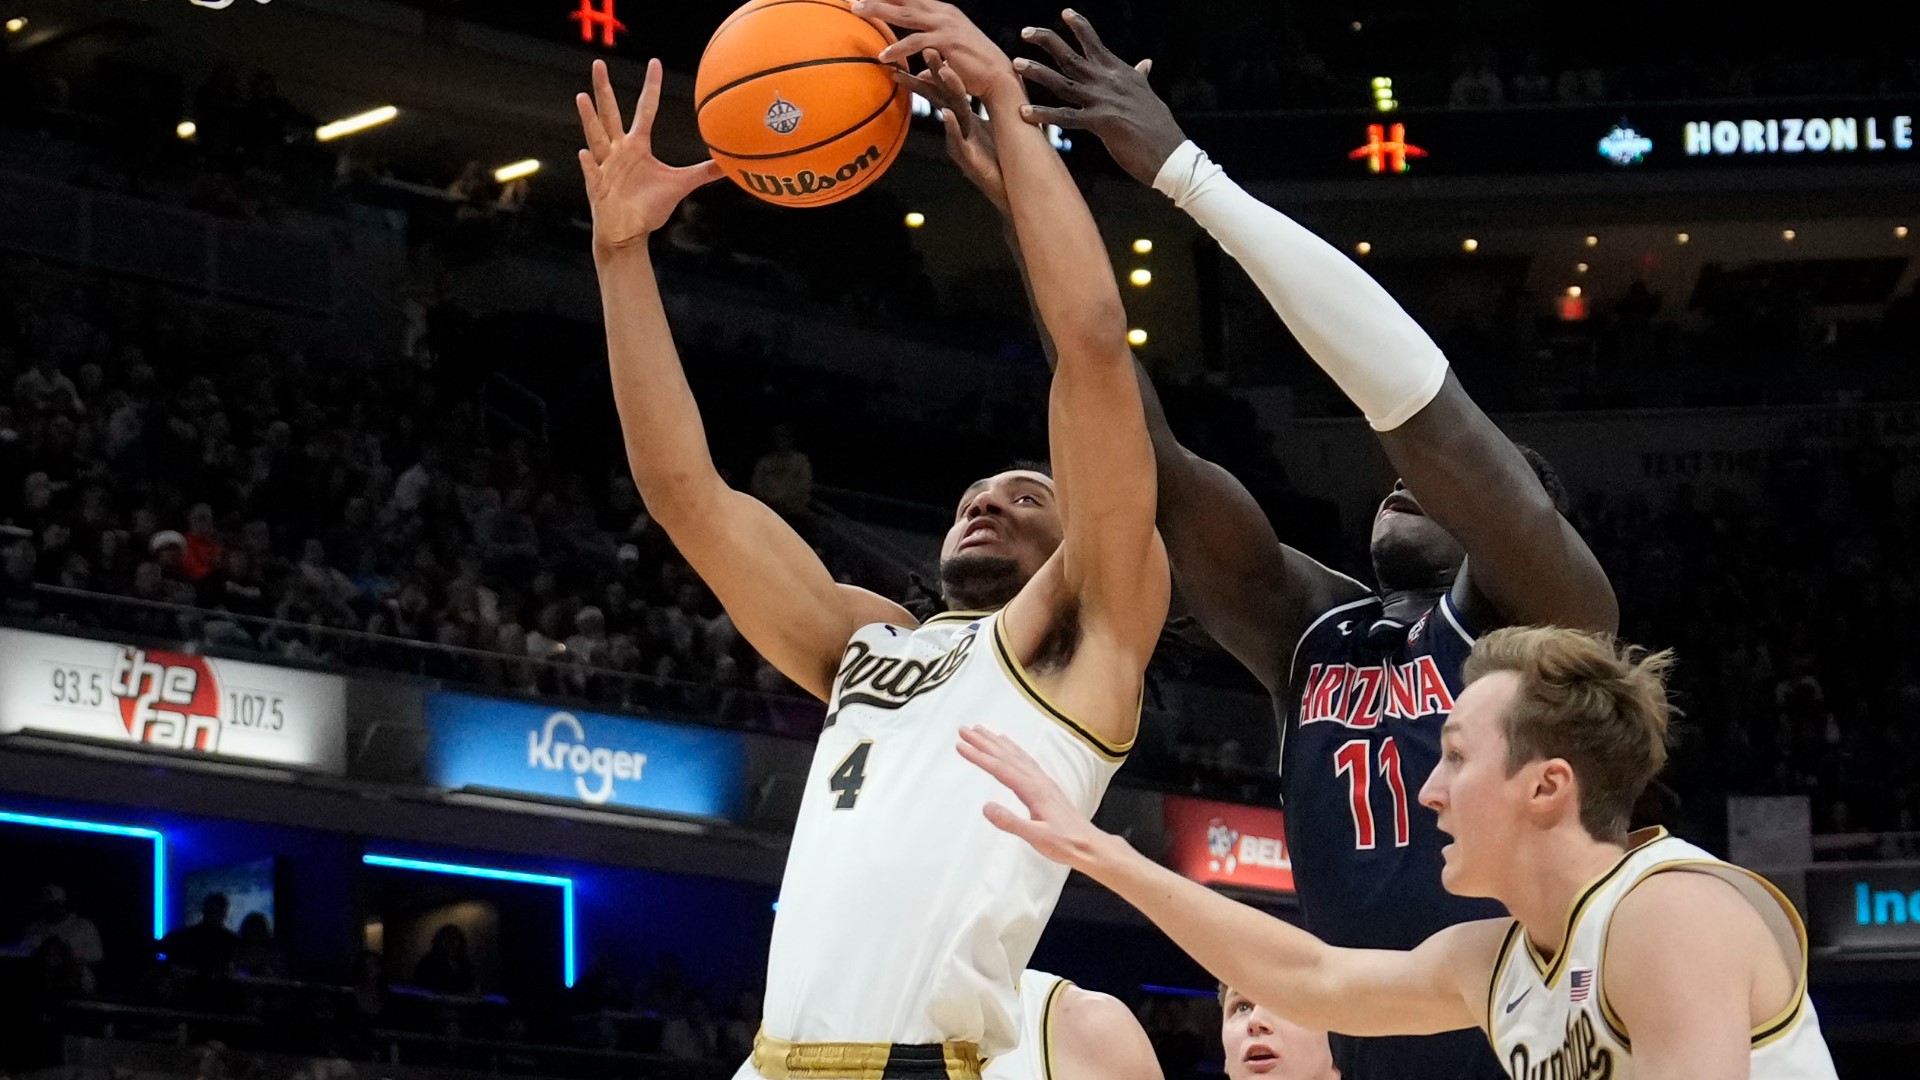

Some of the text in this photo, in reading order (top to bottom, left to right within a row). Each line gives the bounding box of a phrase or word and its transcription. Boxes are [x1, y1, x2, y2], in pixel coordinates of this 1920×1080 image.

[738, 145, 882, 196] Wilson
[1685, 118, 1858, 155] HORIZON
[53, 649, 284, 730] 93.5 the 107.5
[131, 697, 220, 753] fan
[1300, 655, 1455, 729] ARIZNA
[529, 711, 647, 804] Kroger
[827, 739, 875, 811] 4
[1333, 736, 1409, 850] 11
